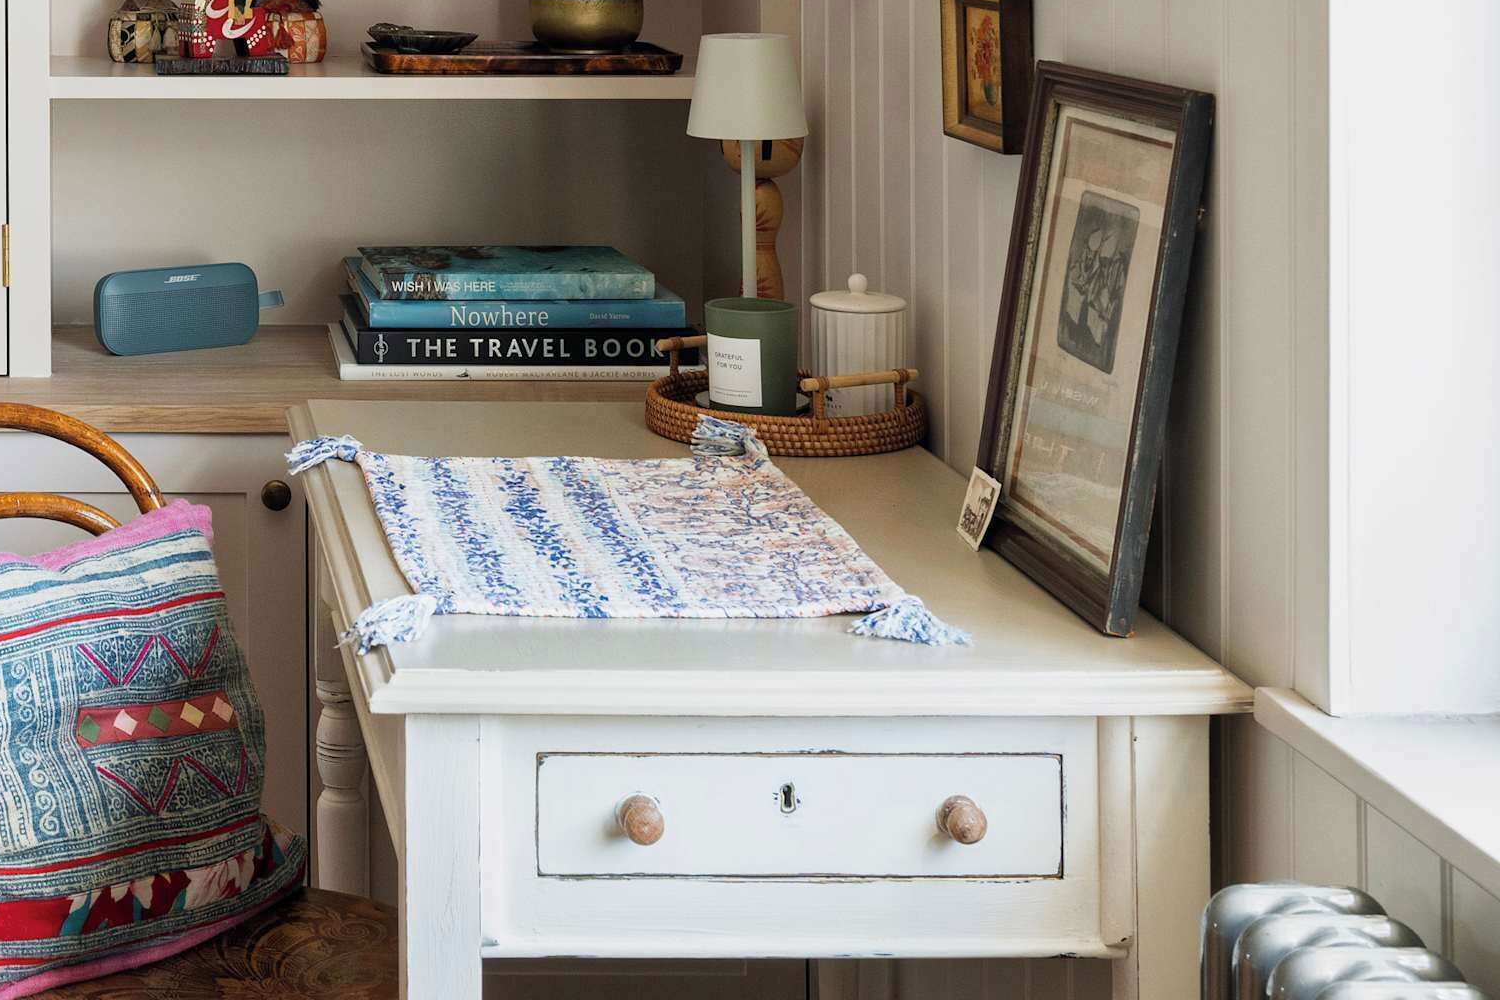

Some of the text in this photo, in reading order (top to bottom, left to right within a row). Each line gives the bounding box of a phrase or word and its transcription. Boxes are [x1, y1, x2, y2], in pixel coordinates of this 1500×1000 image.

[164, 274, 201, 284] BOSE
[391, 280, 424, 292] WISH
[434, 280, 461, 292] WAS
[463, 280, 496, 292] HERE
[450, 305, 550, 327] Nowhere
[407, 338, 665, 358] THE TRAVEL BOOK
[714, 351, 744, 361] GRATEFUL
[729, 363, 742, 371] YOU
[589, 371, 620, 379] JACKIE
